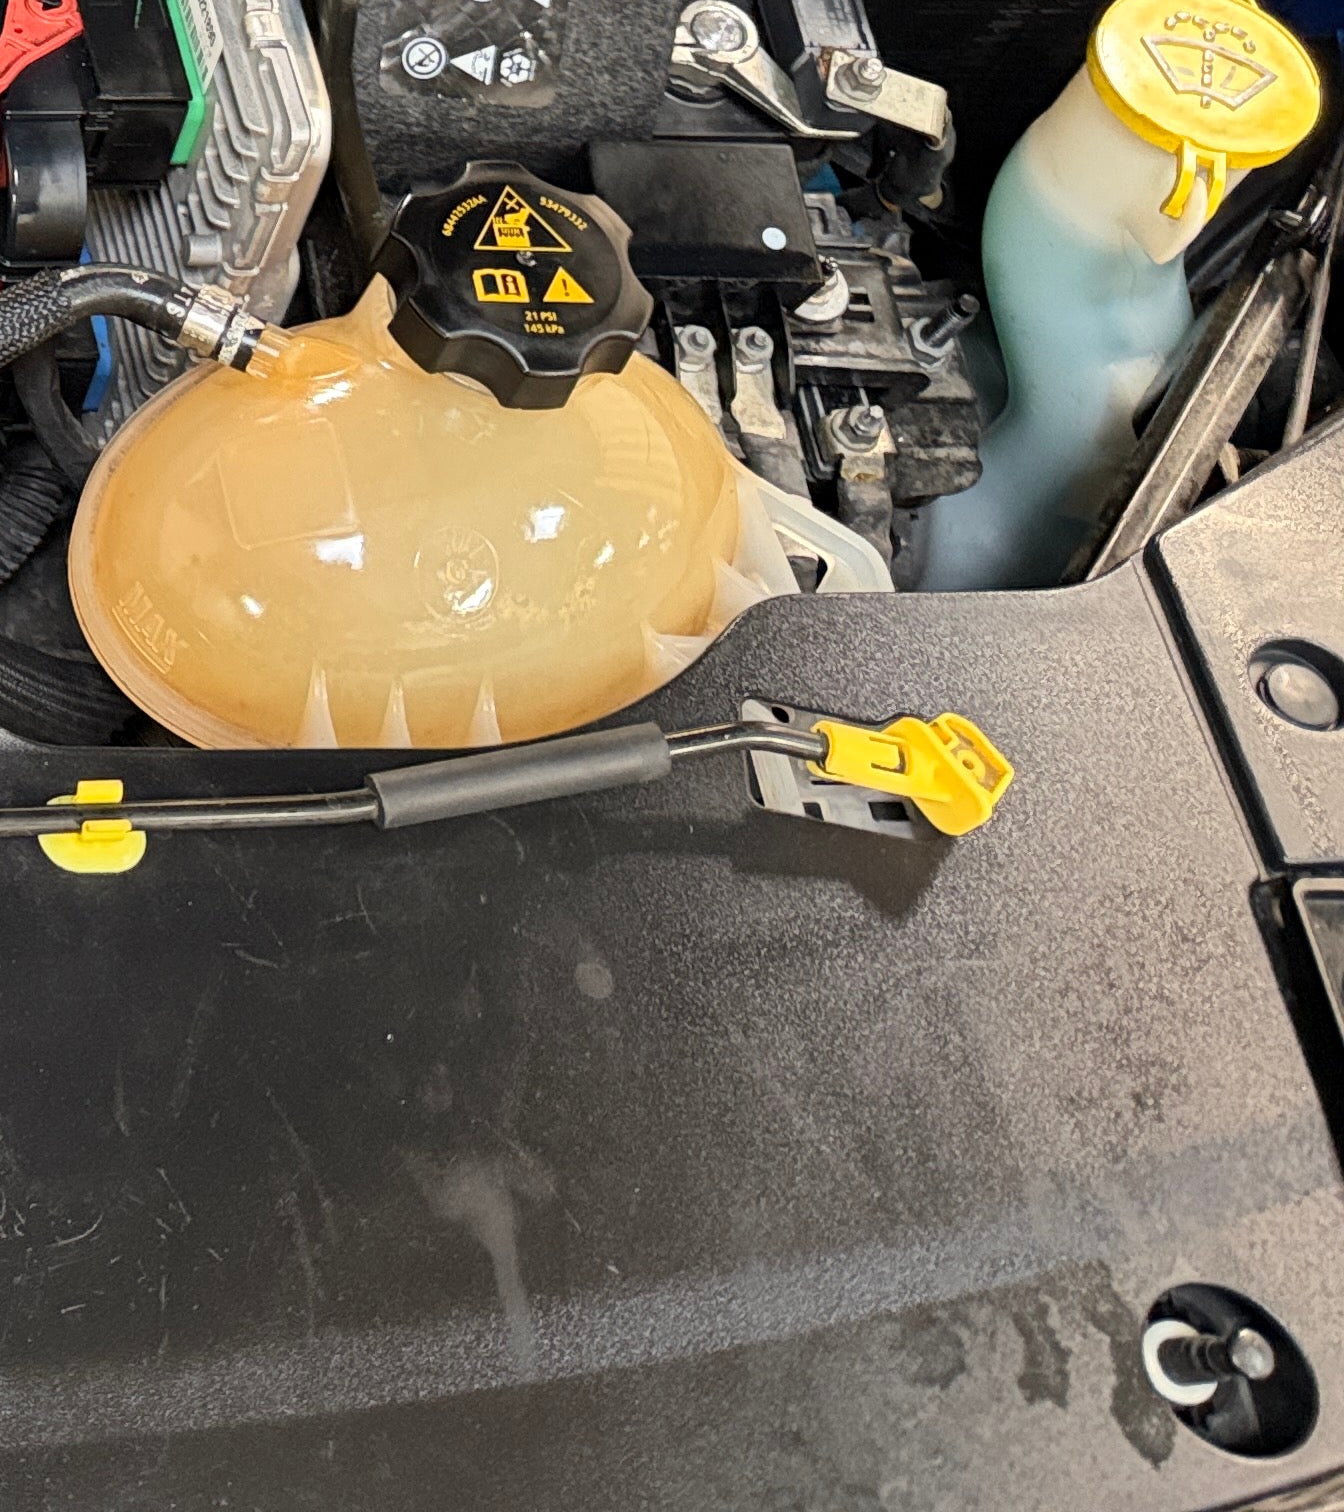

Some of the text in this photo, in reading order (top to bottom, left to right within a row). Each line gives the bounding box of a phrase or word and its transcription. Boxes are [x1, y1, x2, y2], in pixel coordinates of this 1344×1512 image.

[524, 310, 558, 322] 21 PSI
[524, 323, 566, 335] 145 kPa
